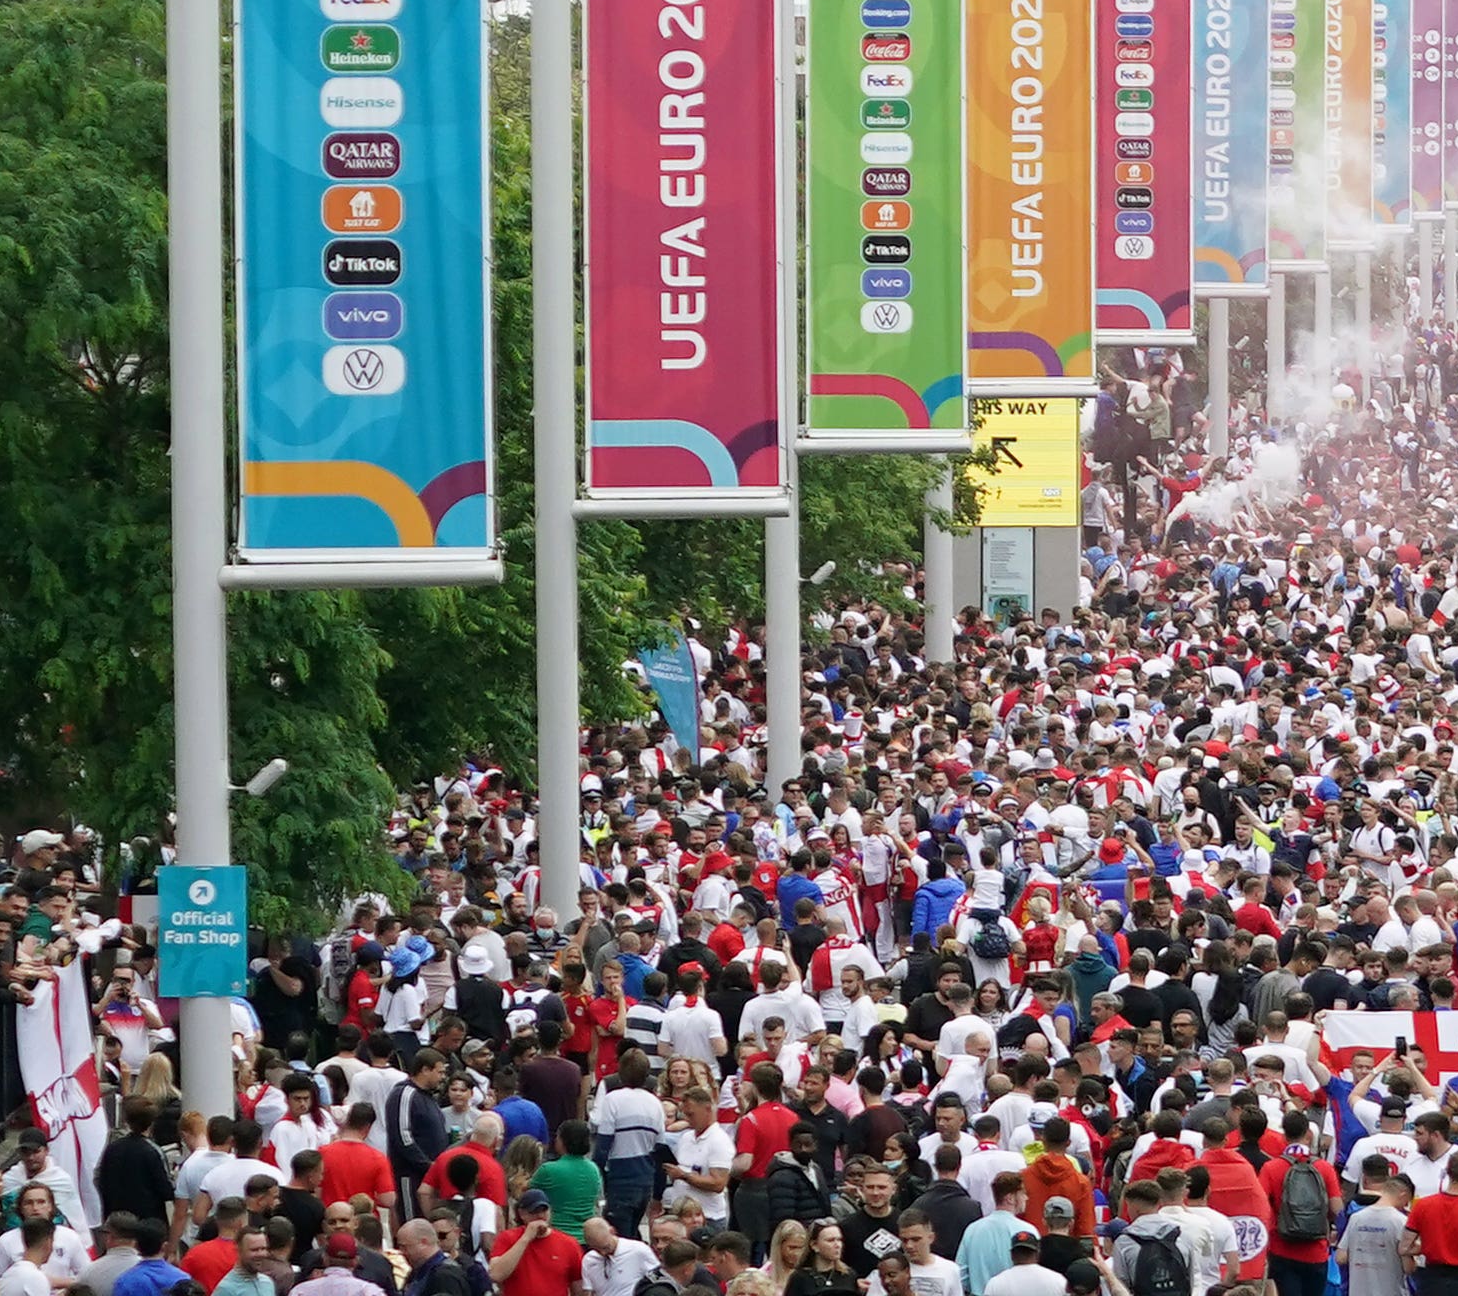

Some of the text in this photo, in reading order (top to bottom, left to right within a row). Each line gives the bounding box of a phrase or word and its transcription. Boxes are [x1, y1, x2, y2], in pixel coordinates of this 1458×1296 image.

[329, 52, 392, 65] Heineken
[867, 75, 905, 86] FedEx
[1204, 48, 1230, 135] EURO
[326, 96, 396, 109] Hisense
[659, 50, 707, 208] EURO
[1011, 76, 1043, 188] EURO
[329, 142, 393, 161] QATAR
[345, 159, 395, 170] AIRWAYS
[866, 173, 907, 185] QATAR
[1203, 142, 1229, 223] UEFA
[1011, 192, 1043, 297] UEFA
[346, 258, 397, 271] TikTok
[660, 216, 707, 370] UEFA
[338, 308, 389, 322] vivo
[1008, 402, 1048, 415] WAY
[171, 911, 233, 926] Official
[164, 930, 241, 947] Fan Shop
[1375, 1146, 1409, 1159] THOMAS
